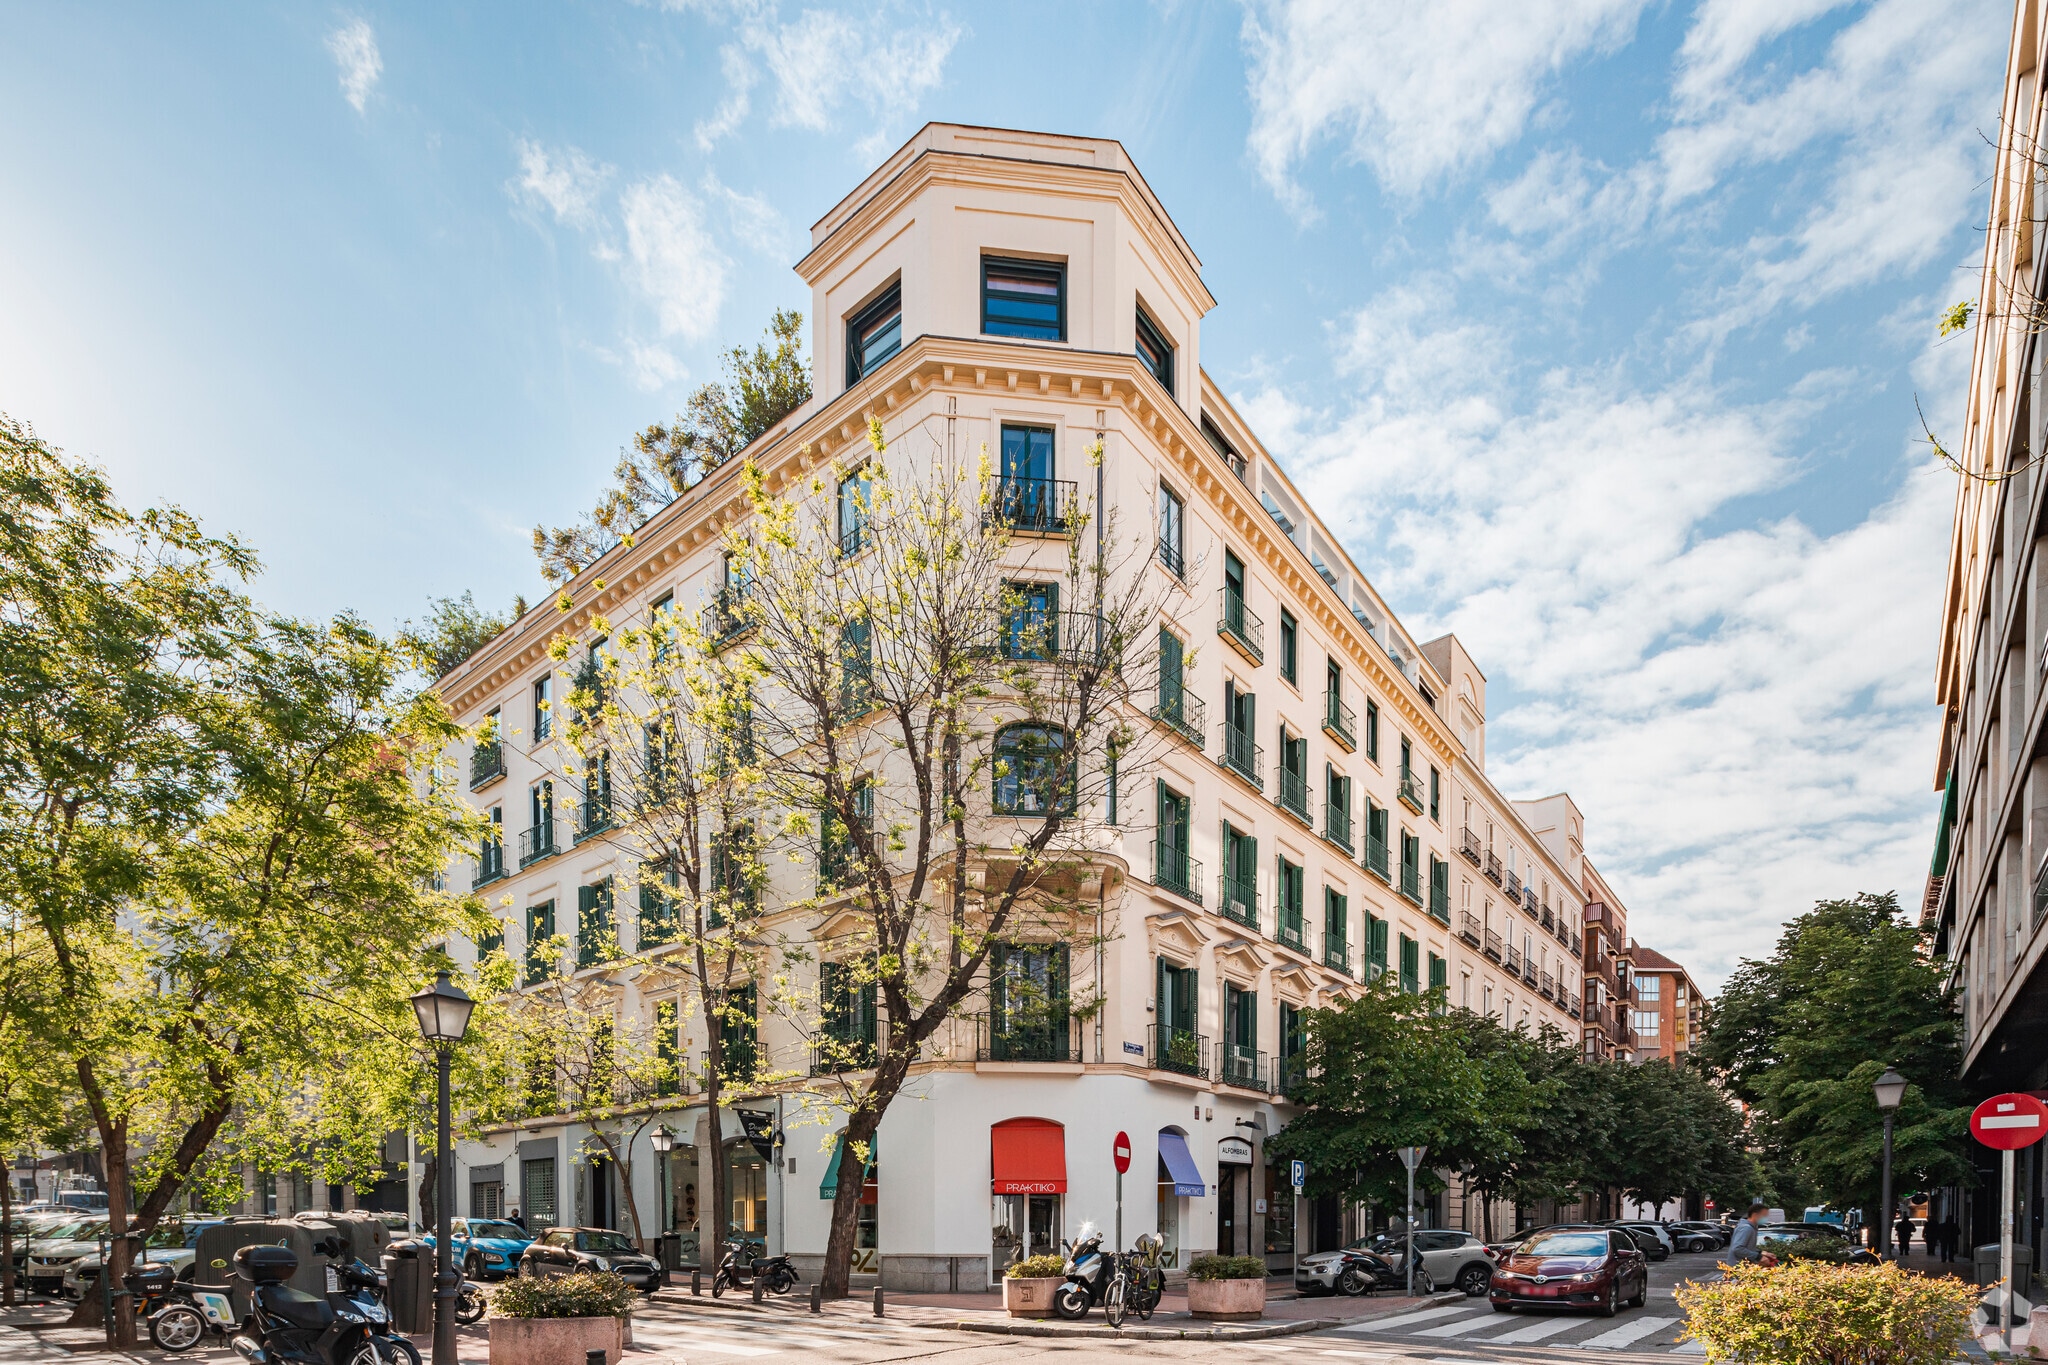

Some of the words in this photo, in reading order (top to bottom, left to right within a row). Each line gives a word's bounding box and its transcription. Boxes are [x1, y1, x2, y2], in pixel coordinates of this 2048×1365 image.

[1222, 1147, 1248, 1156] ALFOMBRAS
[1006, 1183, 1056, 1192] PRAKTIKO
[1178, 1186, 1202, 1195] PRAKTIKO
